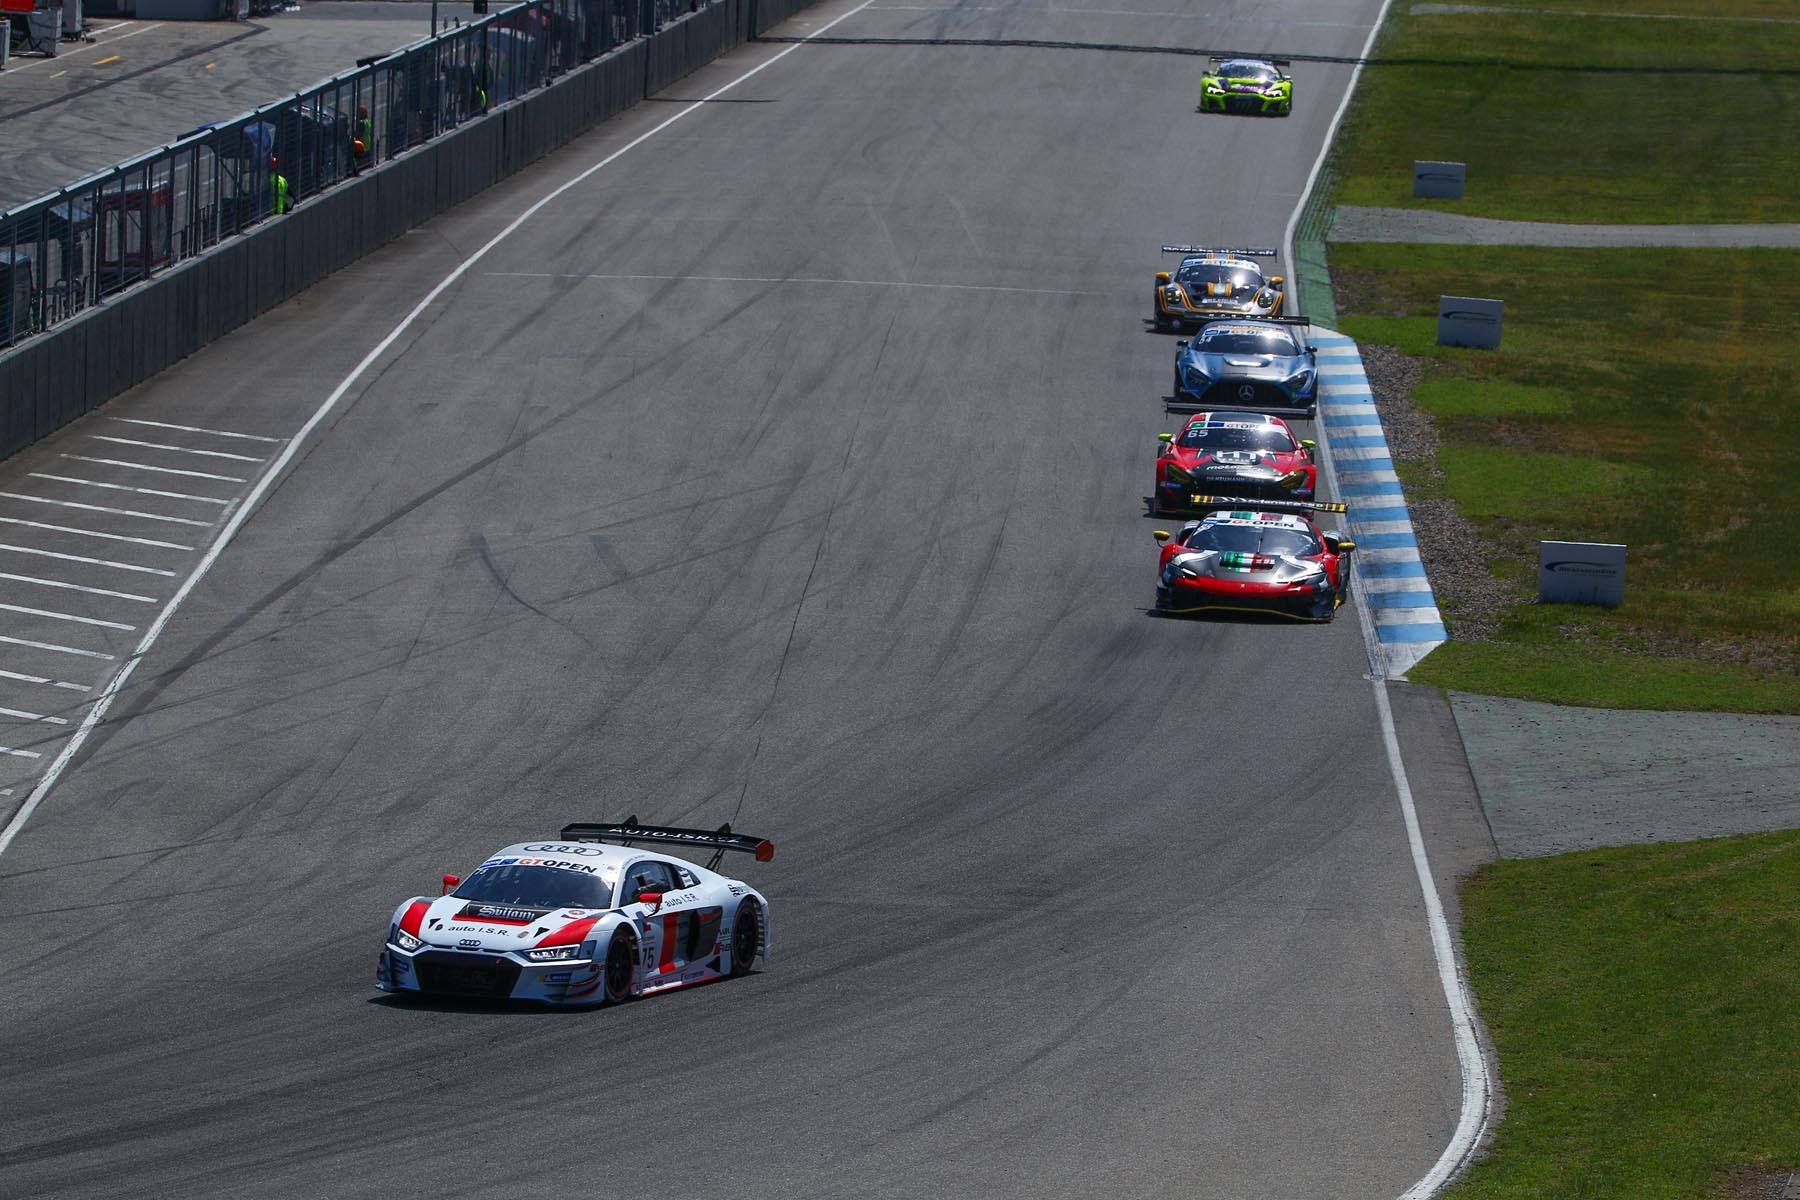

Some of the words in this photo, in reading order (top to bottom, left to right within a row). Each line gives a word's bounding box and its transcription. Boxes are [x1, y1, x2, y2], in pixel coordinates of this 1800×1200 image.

[1187, 429, 1208, 438] 65
[1232, 519, 1294, 528] GTOPEN
[518, 858, 597, 873] GTOPEN
[664, 898, 682, 907] auto
[478, 927, 509, 937] I.S.R.
[642, 946, 654, 969] 75
